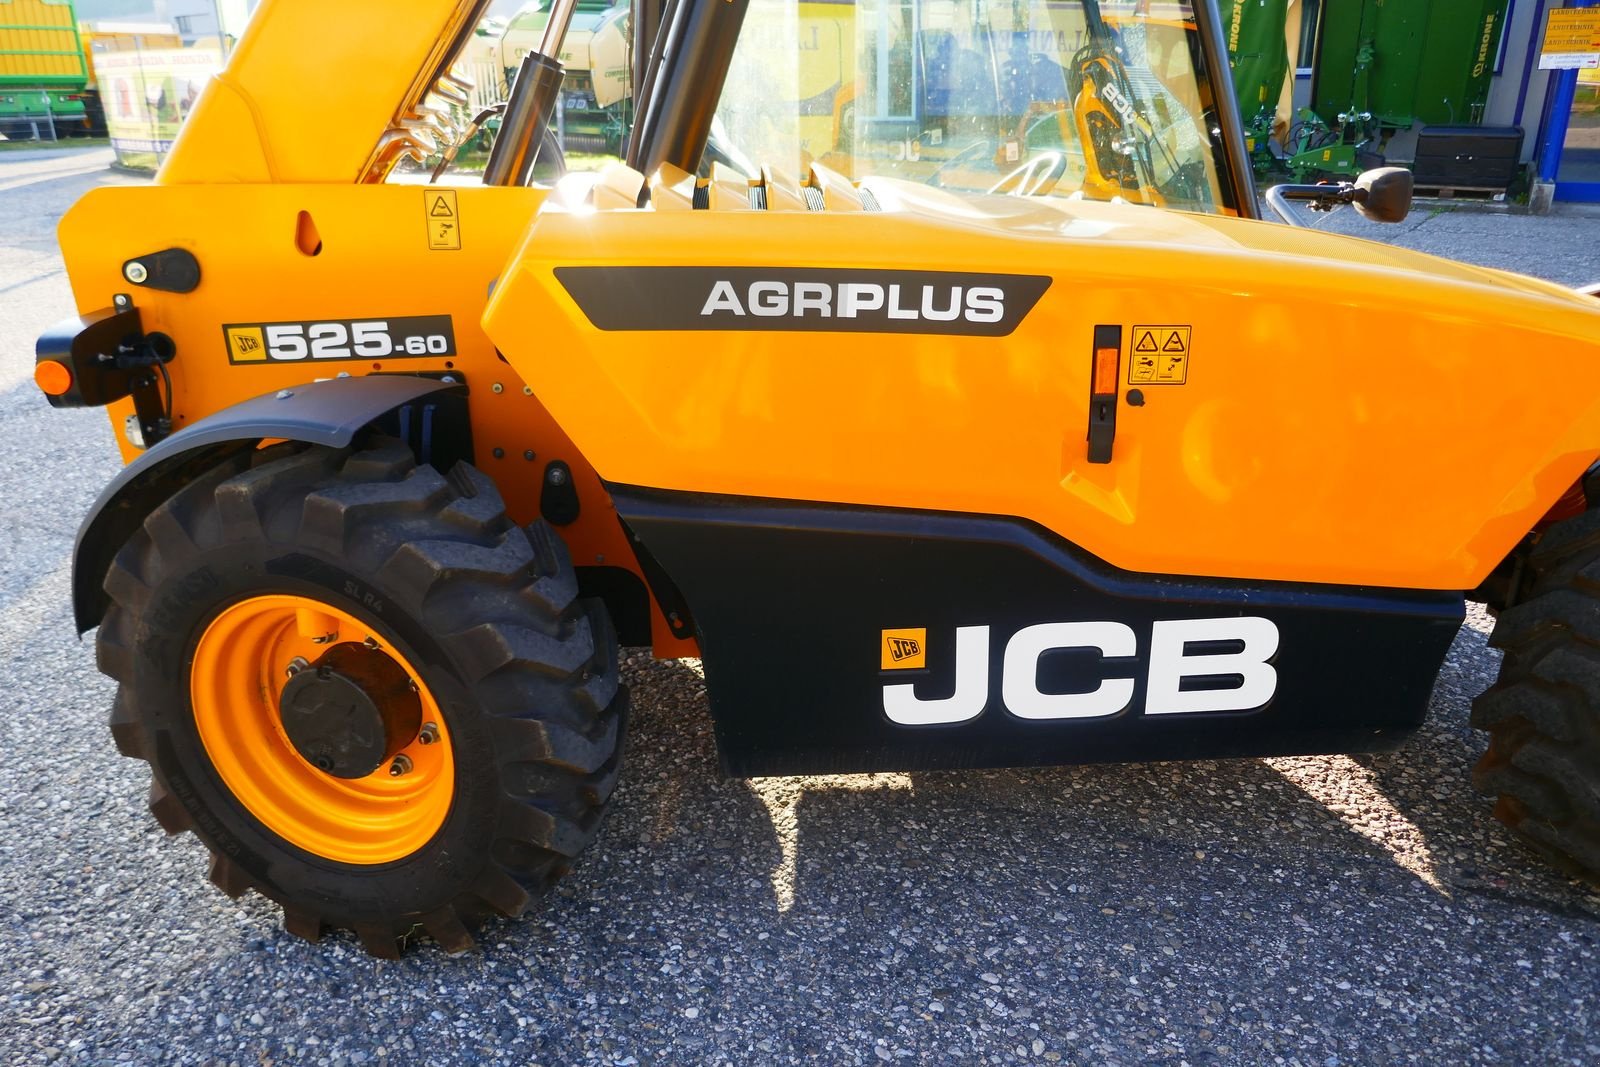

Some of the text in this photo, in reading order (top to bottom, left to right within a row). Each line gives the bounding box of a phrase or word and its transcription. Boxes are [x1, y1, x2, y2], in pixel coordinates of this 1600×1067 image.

[1229, 4, 1242, 53] KRONE
[1478, 14, 1496, 62] KRONE
[700, 280, 1005, 323] AGRIPLUS
[237, 321, 448, 360] JCB 525-60
[343, 580, 361, 599] SL
[882, 615, 1280, 726] JCB
[892, 638, 919, 662] JCB
